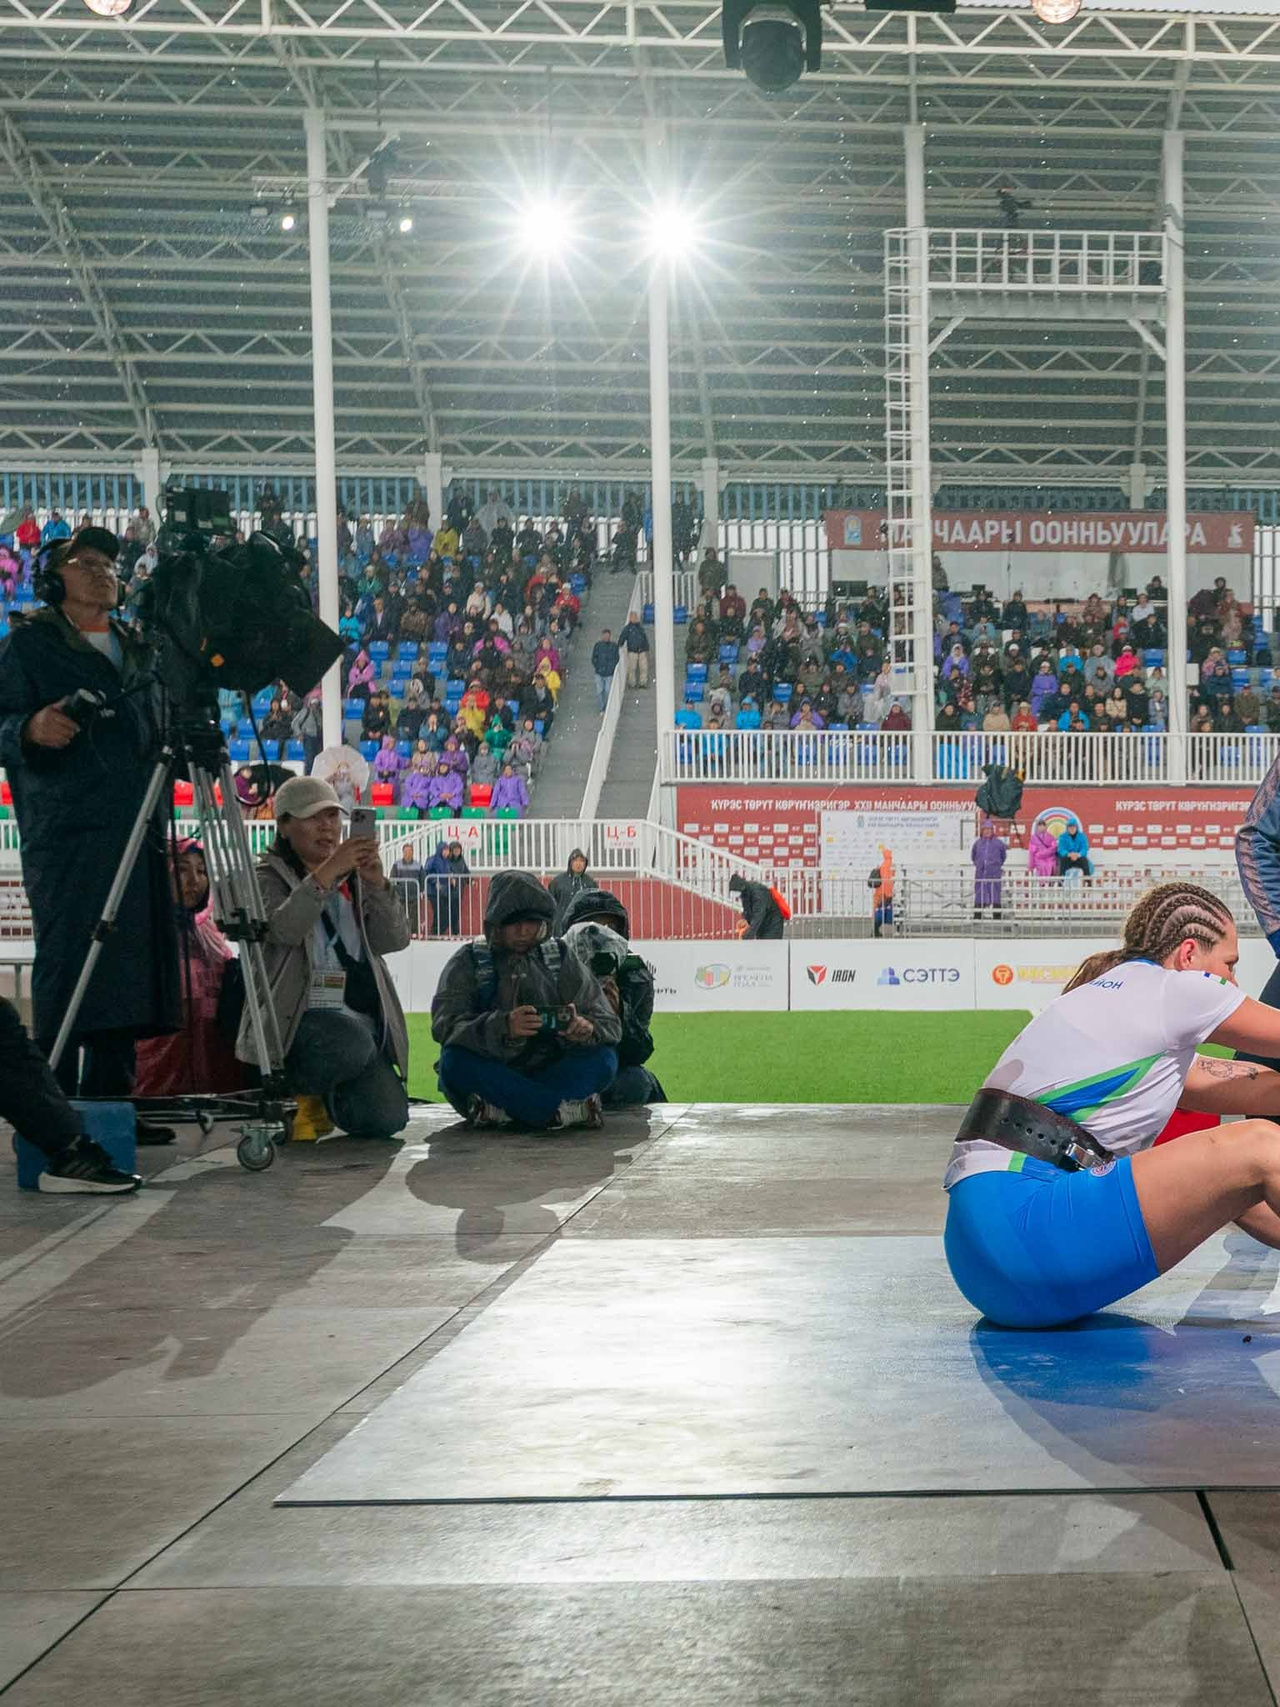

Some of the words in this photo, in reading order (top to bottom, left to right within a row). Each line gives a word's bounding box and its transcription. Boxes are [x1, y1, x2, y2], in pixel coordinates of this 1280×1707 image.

[880, 519, 1021, 544] МАЧААРЫ
[447, 825, 479, 840] Ц-А
[606, 825, 637, 841] Ц-Б
[831, 969, 857, 982] IRON
[903, 968, 961, 983] СЭТТЭ
[1090, 979, 1125, 990] ЙОН
